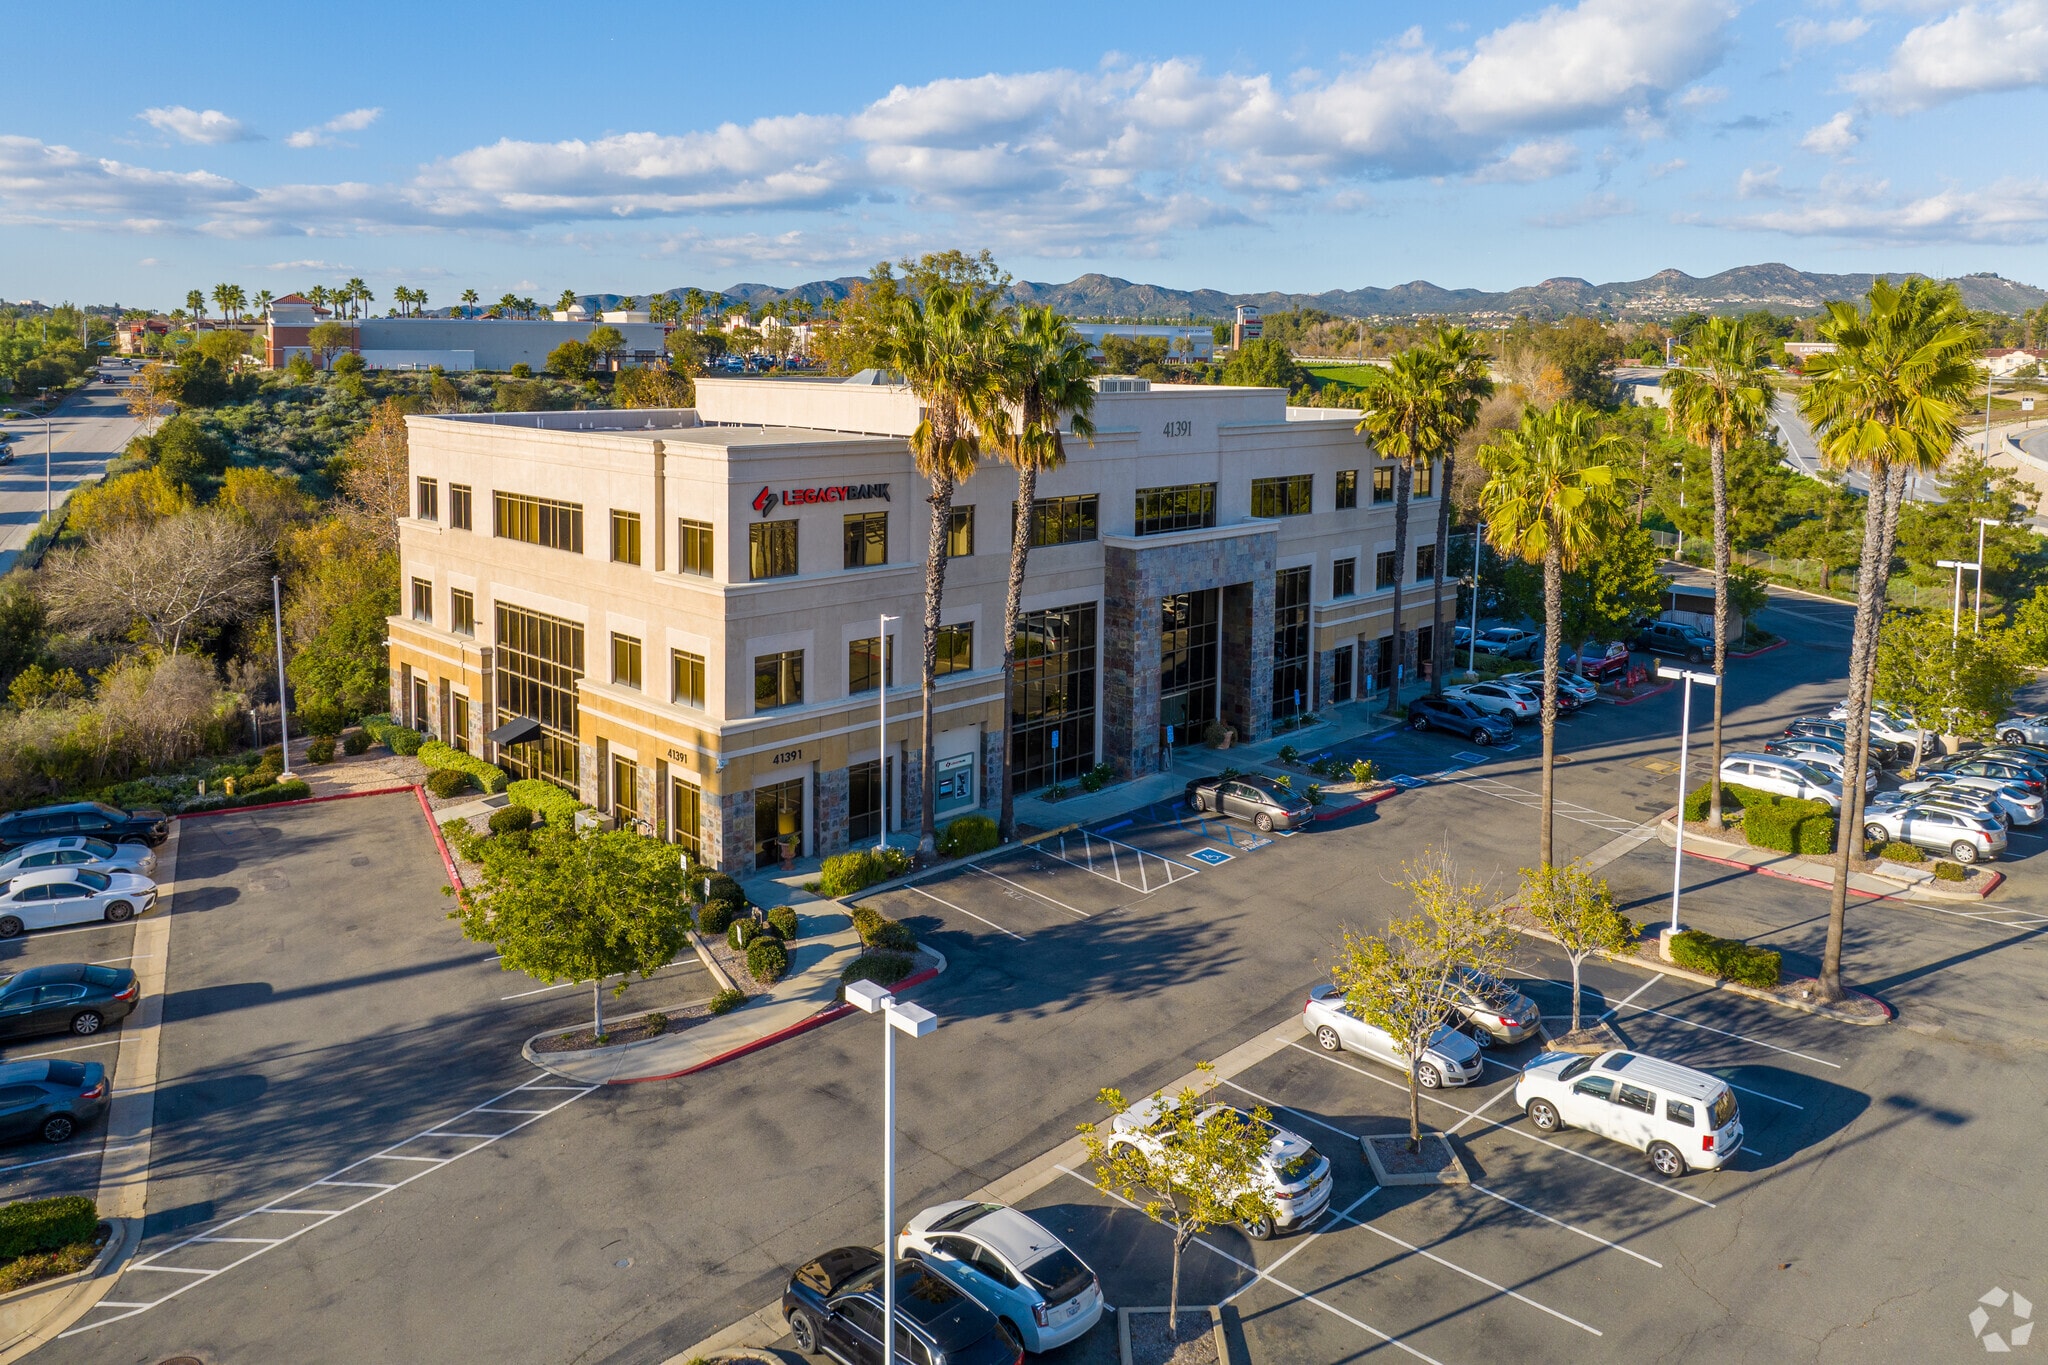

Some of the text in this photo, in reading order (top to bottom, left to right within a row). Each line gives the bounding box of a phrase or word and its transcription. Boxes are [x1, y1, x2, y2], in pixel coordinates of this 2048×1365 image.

[1163, 420, 1192, 438] 41391
[667, 748, 688, 764] 41391
[773, 749, 803, 765] 41391
